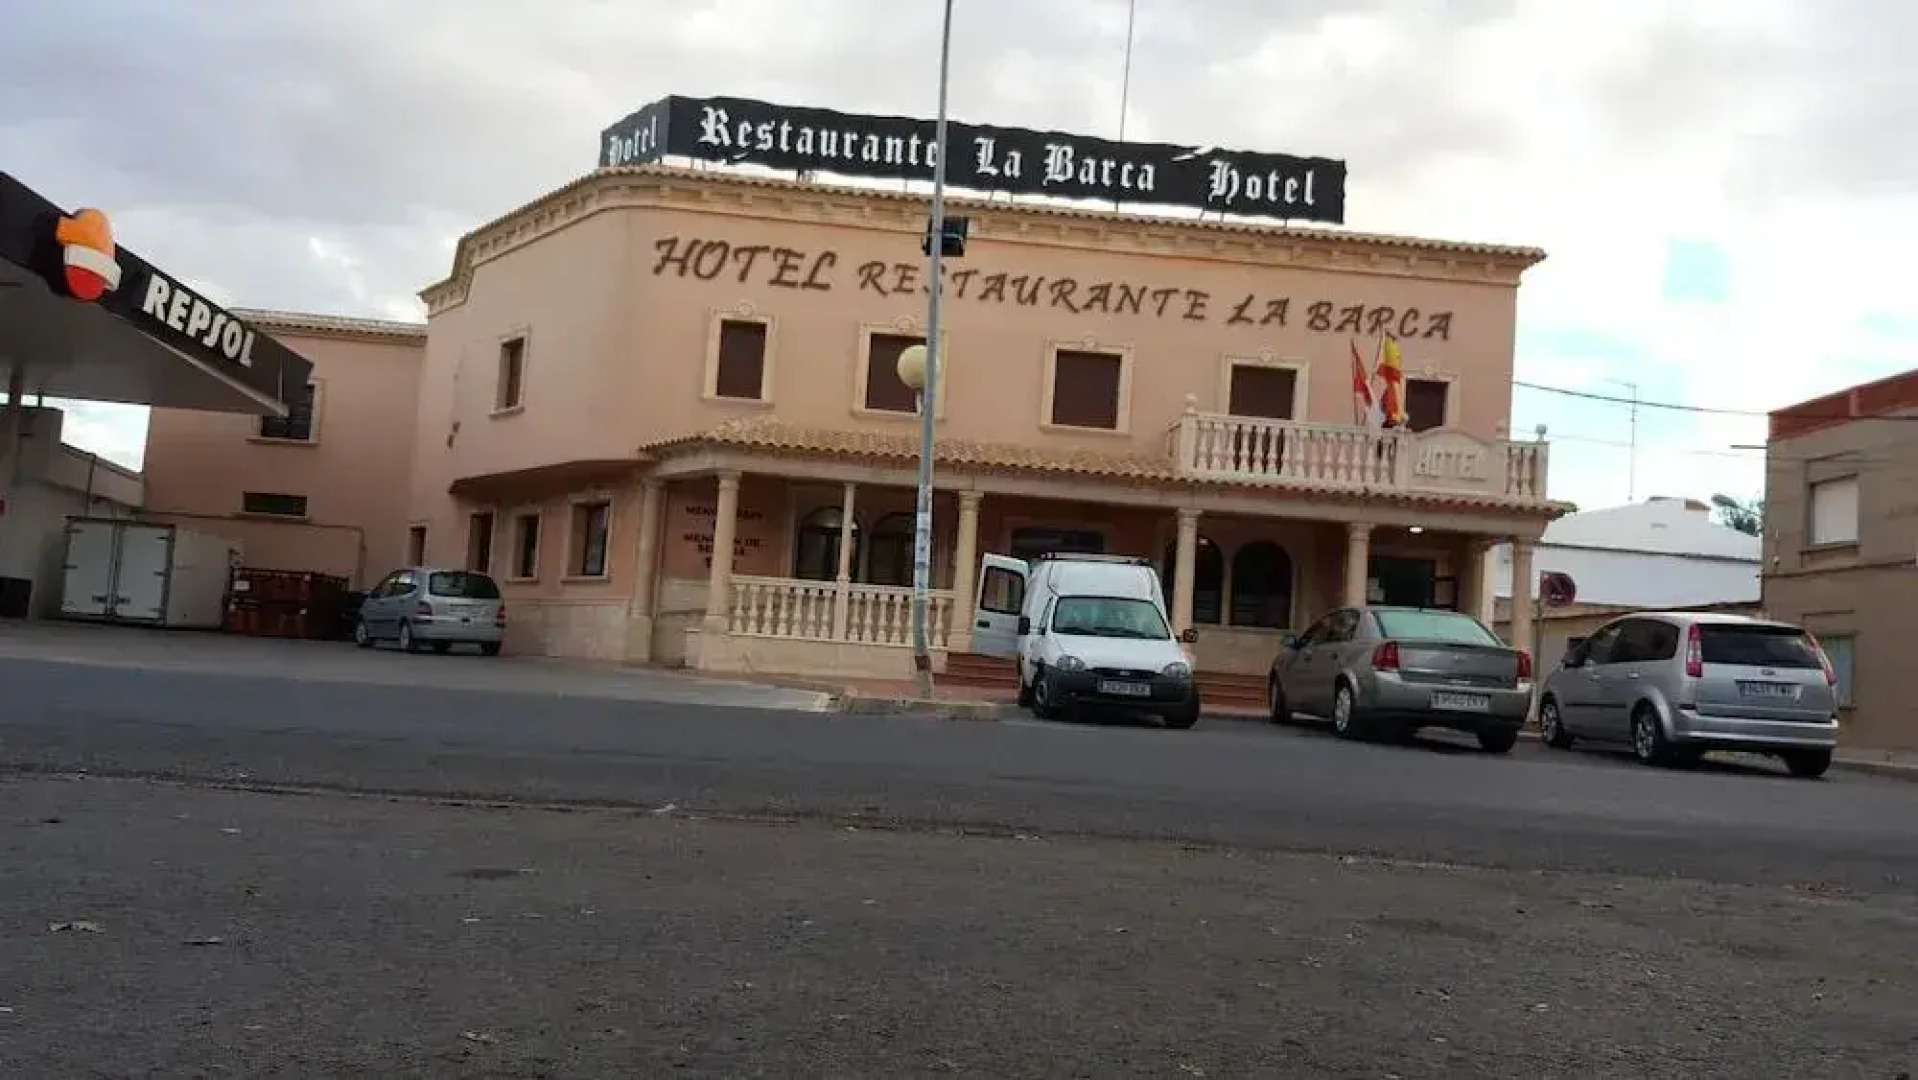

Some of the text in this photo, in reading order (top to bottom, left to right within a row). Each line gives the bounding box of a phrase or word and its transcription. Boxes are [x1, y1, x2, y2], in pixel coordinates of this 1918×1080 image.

[698, 106, 1315, 205] Restaurante La Barca Hotel
[142, 273, 257, 368] REPSOL
[653, 236, 837, 291] HOTEL
[1227, 296, 1289, 326] LA
[1306, 301, 1453, 341] BARCA
